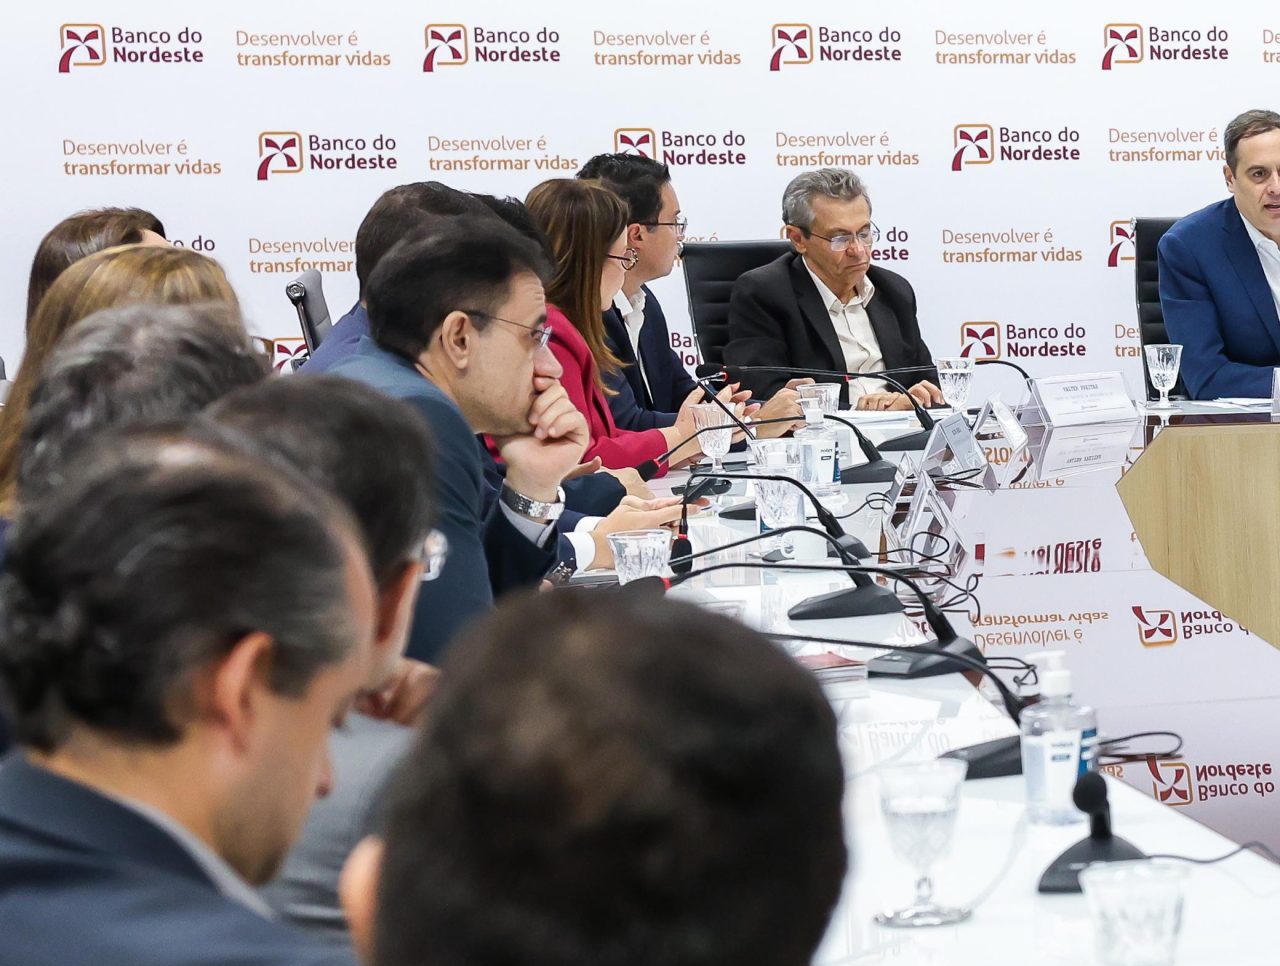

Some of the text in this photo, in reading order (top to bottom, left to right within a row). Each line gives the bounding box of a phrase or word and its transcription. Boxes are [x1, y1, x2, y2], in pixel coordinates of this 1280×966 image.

[112, 27, 202, 43] Banco do
[236, 31, 358, 46] Desenvolver é
[474, 27, 559, 43] Banco do
[594, 30, 710, 46] Desenvolver é
[819, 27, 900, 42] Banco do
[936, 30, 1046, 45] Desenvolver é
[1150, 26, 1228, 42] Banco do
[114, 47, 203, 62] Nordeste
[237, 51, 390, 66] transformar vidas
[475, 46, 560, 62] Nordeste
[594, 50, 741, 65] transformar vidas
[820, 45, 901, 61] Nordeste
[936, 49, 1076, 64] transformar vidas
[1150, 45, 1228, 60] Nordeste
[309, 134, 396, 150] Banco do
[662, 130, 745, 147] Banco do
[776, 131, 889, 147] Desenvolver é
[1000, 127, 1079, 142] Banco do
[1109, 128, 1217, 143] Desenvolver é
[63, 139, 187, 155] Desenvolver é
[428, 135, 546, 151] Desenvolver é
[663, 150, 746, 165] Nordeste
[776, 151, 919, 166] transformar vidas
[1001, 145, 1080, 160] Nordeste
[1109, 147, 1202, 161] transformar
[64, 159, 221, 175] transformar vidas
[310, 154, 397, 169] Nordeste
[429, 155, 578, 170] transformar vidas
[887, 227, 908, 242] do
[943, 228, 1053, 244] Desenvolver é
[192, 236, 215, 251] do
[249, 237, 355, 254] Desenvolver
[871, 246, 909, 260] este
[943, 247, 1082, 263] transformar vidas
[1007, 323, 1085, 339] Banco do
[1007, 342, 1086, 357] Nordeste
